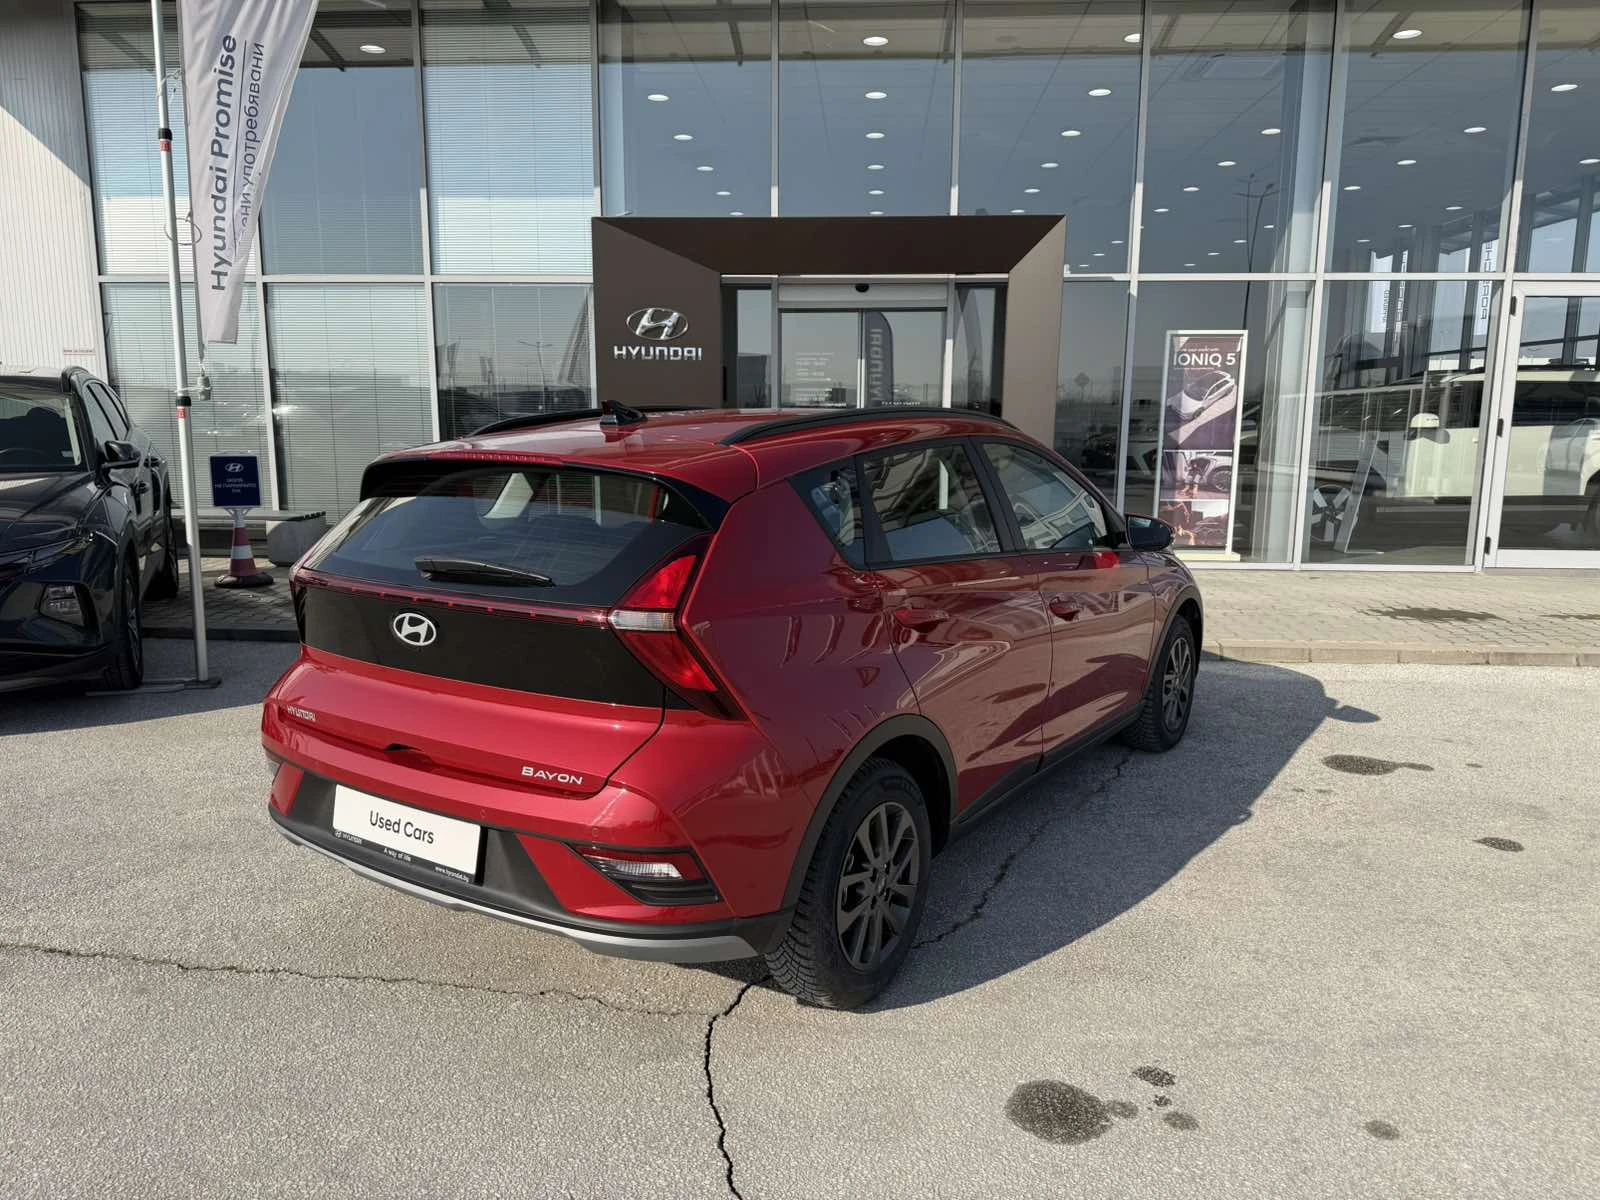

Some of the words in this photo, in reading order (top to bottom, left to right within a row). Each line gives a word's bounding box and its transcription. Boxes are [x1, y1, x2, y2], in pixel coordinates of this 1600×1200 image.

[211, 35, 237, 160] Promise
[243, 43, 264, 187] употребявани
[210, 166, 232, 290] Hyundai
[613, 345, 703, 361] HYUNDAI
[1173, 353, 1222, 367] IONIQ
[1225, 353, 1236, 366] 5
[287, 704, 317, 722] HYUNDAI
[521, 766, 583, 785] BAYON
[369, 810, 401, 835] Used
[403, 820, 435, 845] Cars
[388, 850, 397, 858] way
